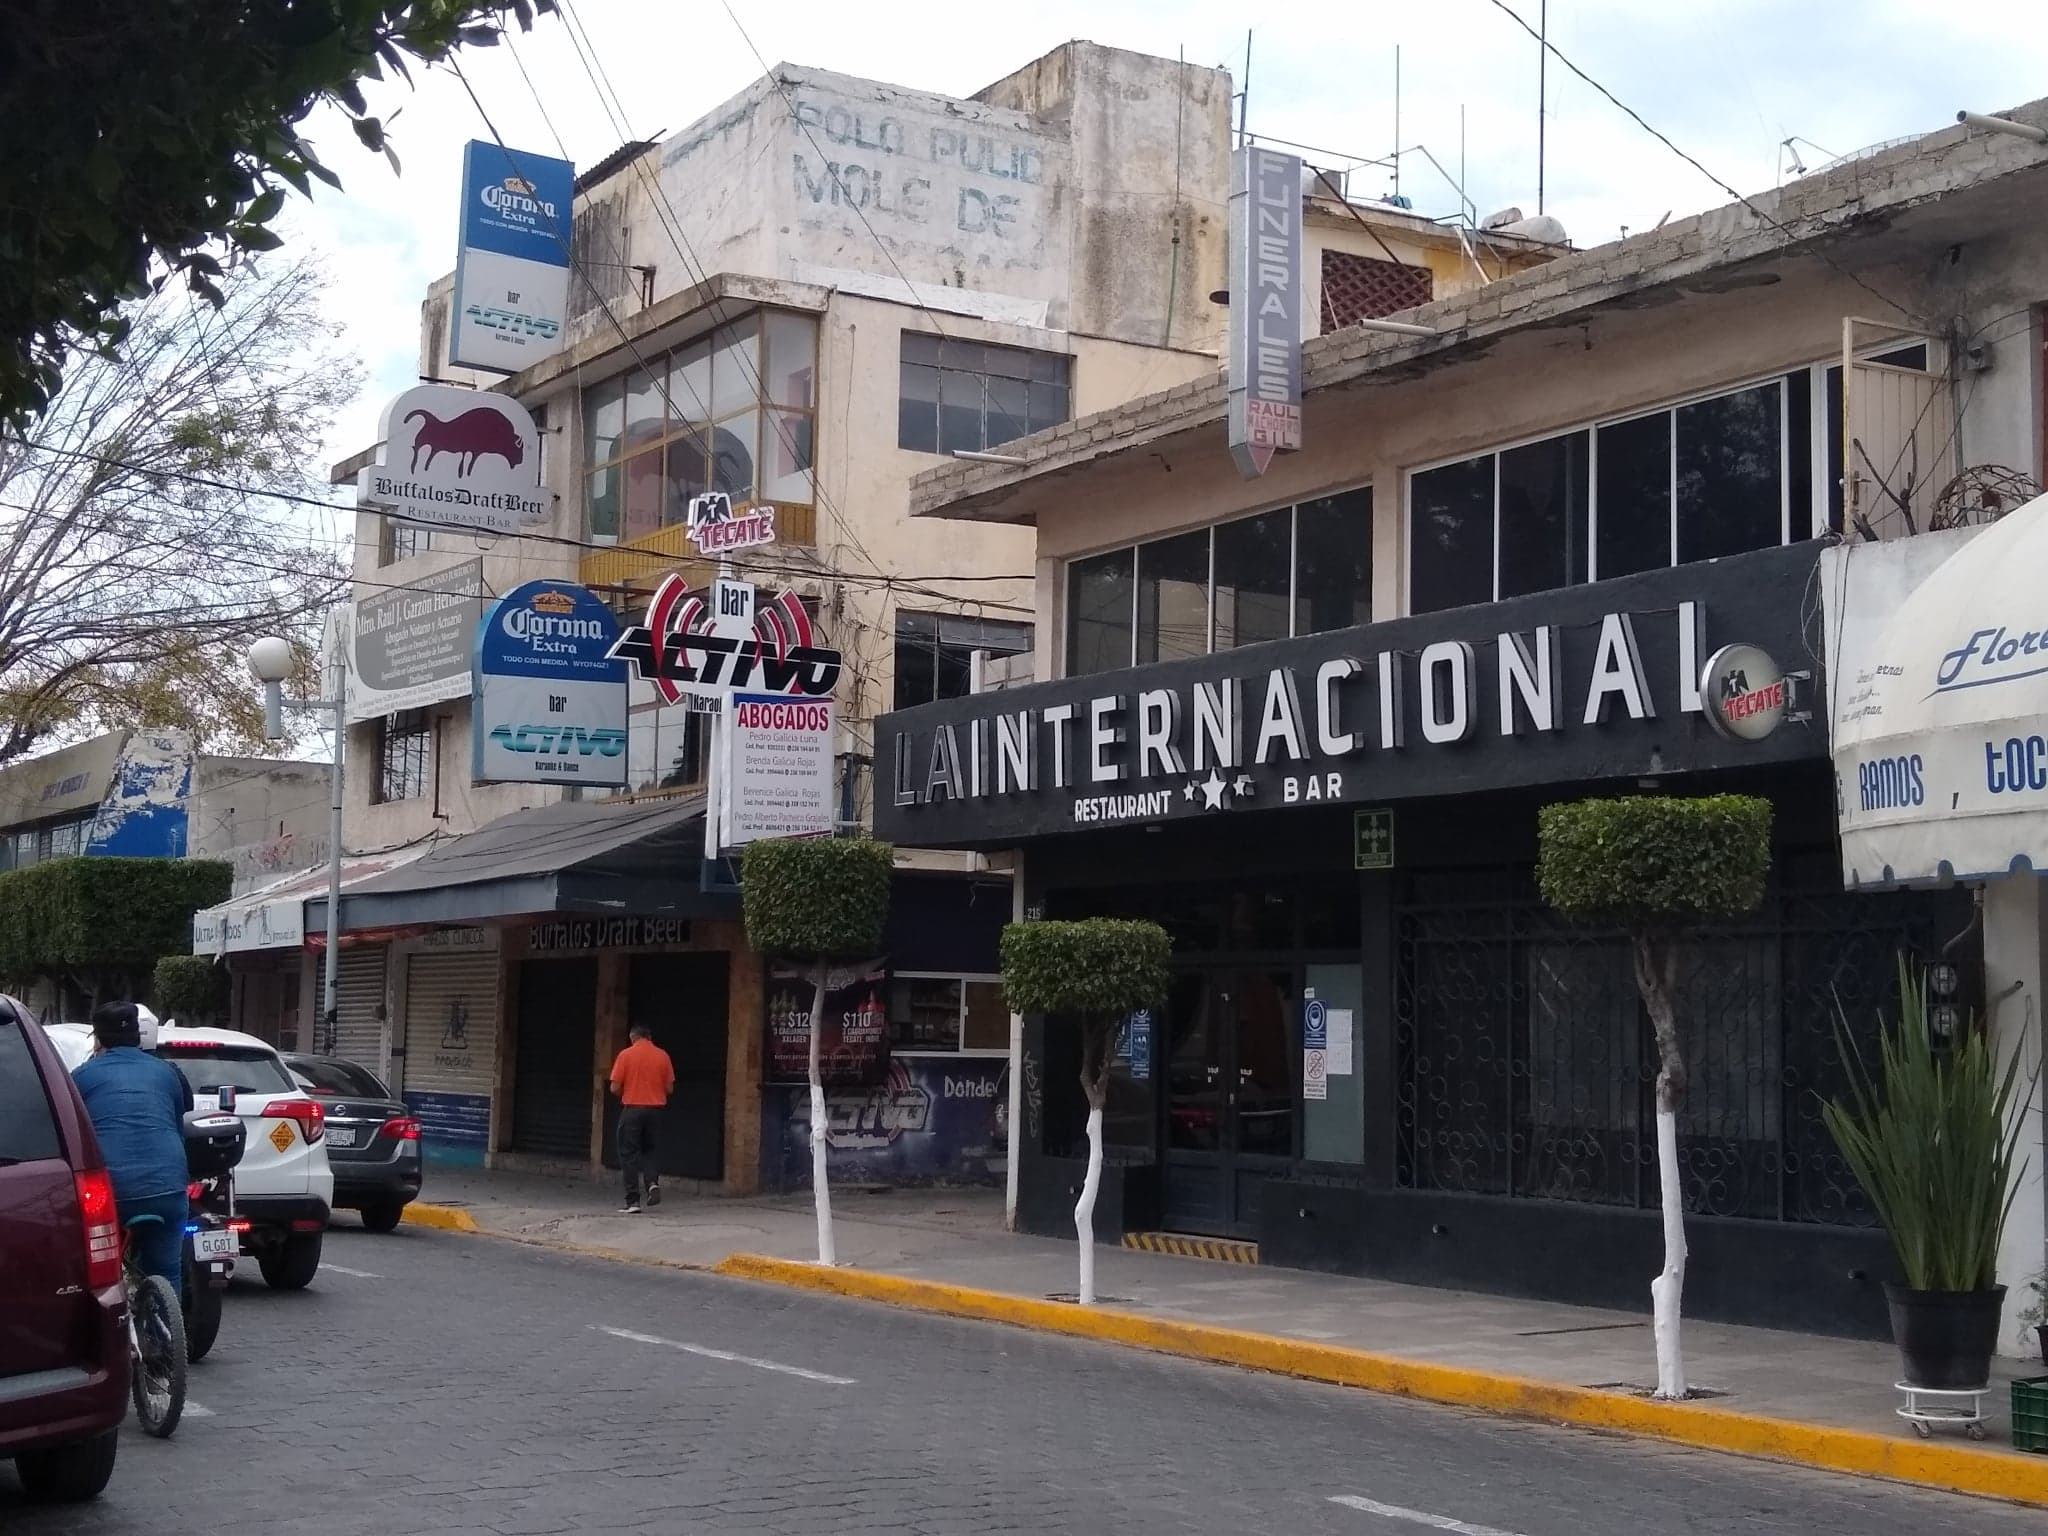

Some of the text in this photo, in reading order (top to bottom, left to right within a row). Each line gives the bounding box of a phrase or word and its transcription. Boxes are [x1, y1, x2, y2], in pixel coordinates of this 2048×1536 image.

[480, 185, 558, 218] Corona
[502, 207, 536, 226] Extra
[1257, 151, 1291, 401] FUNERALES
[1249, 401, 1299, 420] RAUL
[1254, 429, 1293, 448] GIL
[701, 516, 772, 548] TECATE
[721, 584, 749, 617] bar
[502, 607, 603, 643] Corona
[533, 636, 578, 655] Extra
[549, 694, 567, 712] bar
[971, 600, 1705, 797] INTERNACIONAL
[1724, 682, 1784, 721] TECATE
[738, 703, 829, 732] ABOGADOS
[1859, 753, 1925, 812] RAMOS
[1985, 735, 2048, 794] tOC
[1074, 772, 1343, 822] RESTAURANT BAR
[843, 1011, 872, 1028] $110
